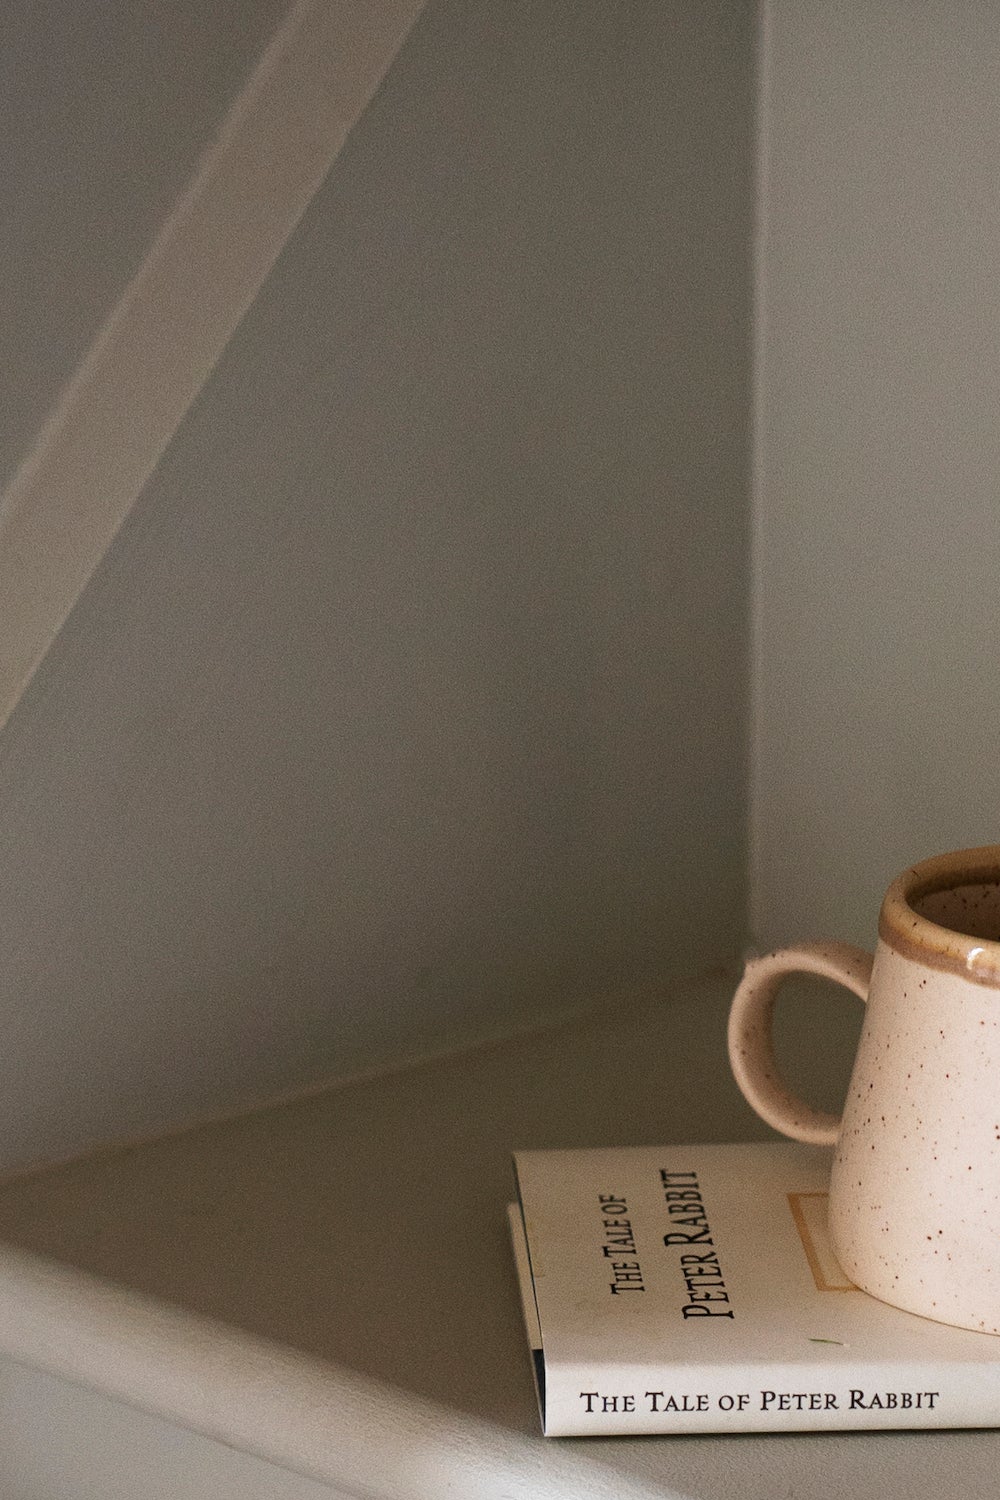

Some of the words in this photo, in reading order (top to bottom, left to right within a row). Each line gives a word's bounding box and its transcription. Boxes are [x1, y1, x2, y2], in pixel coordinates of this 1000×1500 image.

[659, 1168, 714, 1247] RABBIT
[603, 1217, 637, 1259] TALE
[609, 1257, 646, 1295] THE
[681, 1251, 735, 1320] PETER
[579, 1392, 636, 1413] THE
[645, 1391, 710, 1412] TALE
[717, 1393, 750, 1411] OF
[760, 1390, 839, 1411] PETER
[848, 1389, 940, 1410] RABBIT
